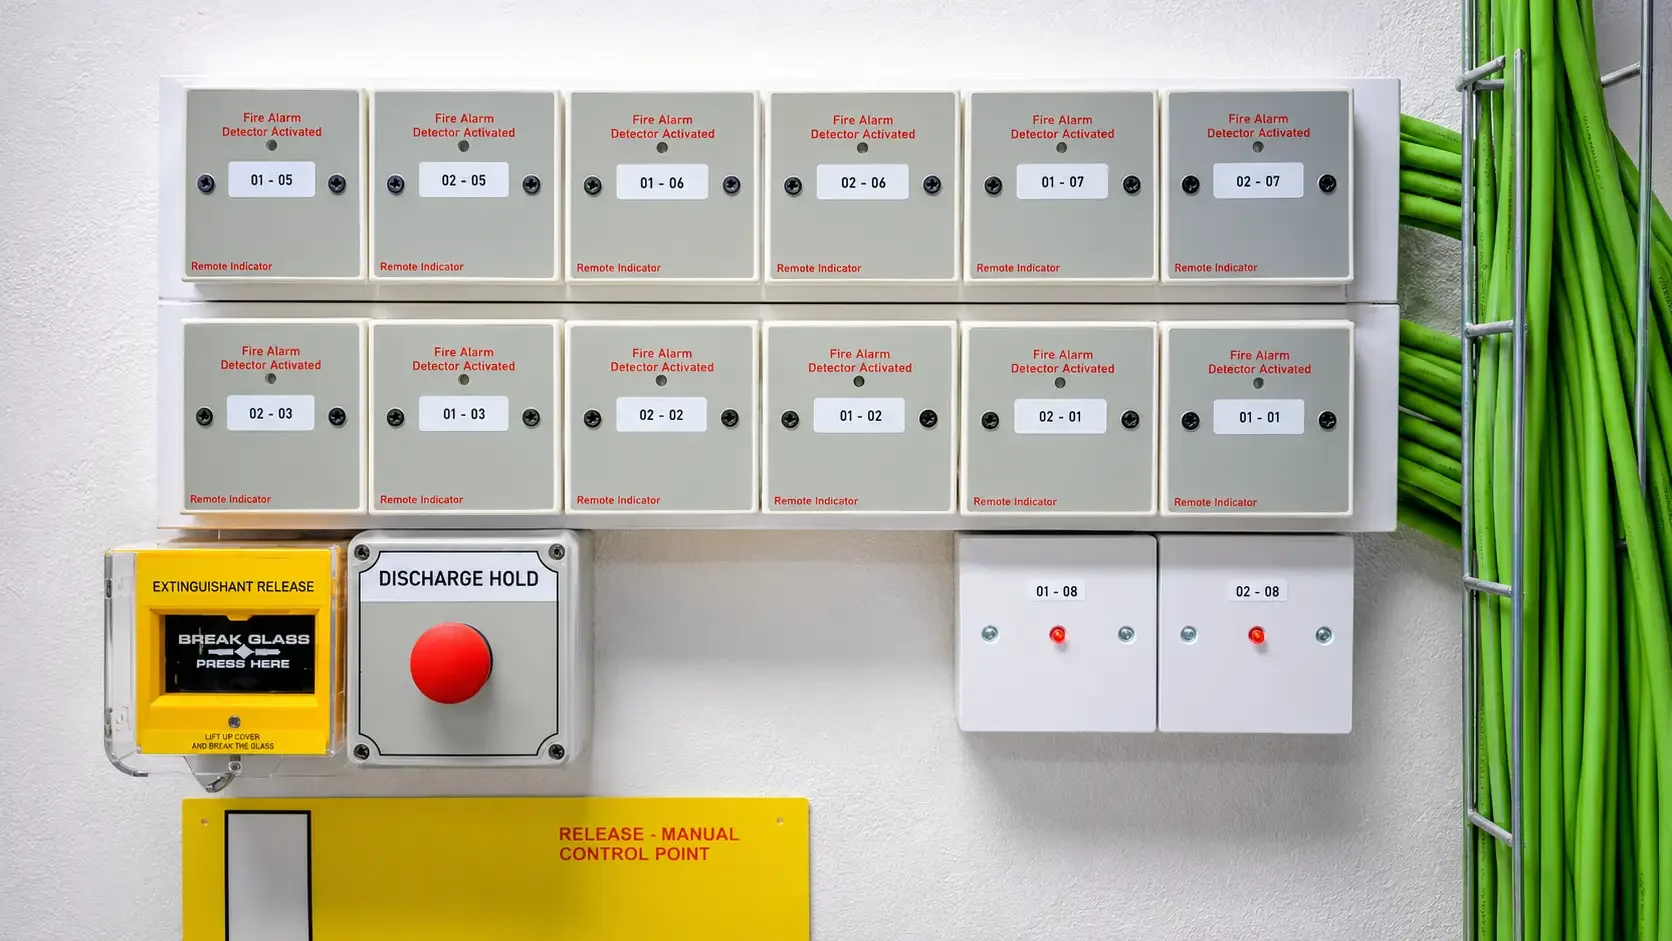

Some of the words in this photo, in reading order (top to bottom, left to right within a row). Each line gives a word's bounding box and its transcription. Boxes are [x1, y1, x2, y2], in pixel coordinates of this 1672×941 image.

[243, 112, 265, 123] Fire
[268, 112, 301, 123] Alarm
[435, 112, 458, 123] Fire
[460, 113, 495, 124] Alarm
[632, 114, 655, 124] Fire
[658, 114, 692, 125] Alarm
[833, 114, 856, 126] Fire
[859, 115, 894, 126] Alarm
[1033, 114, 1055, 124] Fire
[1058, 115, 1092, 126] Alarm
[1228, 114, 1250, 123] Fire
[1253, 114, 1288, 124] Alarm
[222, 127, 268, 137] Detector
[271, 126, 322, 137] Activated
[413, 128, 460, 137] Detector
[464, 128, 516, 138] Activated
[611, 128, 659, 139] Detector
[662, 128, 716, 139] Activated
[811, 129, 859, 139] Detector
[862, 129, 916, 140] Activated
[1011, 129, 1059, 139] Detector
[1062, 128, 1115, 139] Activated
[1208, 128, 1254, 138] Detector
[1258, 128, 1310, 137] Activated
[250, 173, 263, 186] 01
[278, 173, 293, 186] 05
[441, 174, 457, 187] 02
[471, 174, 486, 187] 05
[640, 176, 653, 189] 01
[669, 176, 684, 189] 06
[841, 176, 856, 189] 02
[871, 176, 887, 189] 06
[1041, 175, 1054, 189] 01
[1069, 175, 1085, 188] 07
[1236, 175, 1251, 188] 02
[1265, 175, 1280, 187] 07
[191, 261, 228, 271] Remote
[230, 261, 273, 271] Indicator
[380, 262, 418, 272] Remote
[420, 262, 464, 272] Indicator
[576, 264, 615, 273] Remote
[617, 264, 661, 273] Indicator
[776, 264, 815, 273] Remote
[818, 264, 861, 273] Indicator
[976, 264, 1015, 272] Remote
[1017, 264, 1060, 273] Indicator
[1175, 263, 1212, 272] Remote
[1215, 264, 1256, 272] Indicator
[242, 346, 264, 356] Fire
[266, 346, 300, 357] Alarm
[434, 346, 456, 358] Fire
[459, 347, 495, 357] Alarm
[632, 348, 655, 359] Fire
[657, 348, 692, 359] Alarm
[829, 348, 853, 359] Fire
[856, 348, 891, 359] Alarm
[1033, 349, 1055, 360] Fire
[1059, 350, 1093, 360] Alarm
[1230, 350, 1252, 360] Fire
[1256, 350, 1290, 360] Alarm
[221, 360, 266, 370] Detector
[270, 360, 321, 370] Activated
[412, 360, 459, 371] Detector
[463, 361, 516, 371] Activated
[610, 361, 658, 372] Detector
[661, 362, 715, 372] Activated
[808, 362, 856, 373] Detector
[859, 363, 912, 373] Activated
[1011, 363, 1059, 374] Detector
[1062, 364, 1115, 374] Activated
[1208, 364, 1255, 374] Detector
[1259, 364, 1312, 374] Activated
[249, 407, 264, 420] 02
[278, 407, 293, 420] 03
[443, 407, 456, 420] 01
[470, 407, 486, 420] 03
[639, 408, 654, 421] 02
[669, 408, 684, 421] 02
[839, 409, 852, 422] 01
[867, 409, 882, 422] 02
[1039, 410, 1054, 423] 02
[1068, 410, 1081, 423] 01
[1239, 411, 1252, 424] 01
[1267, 411, 1280, 424] 01
[189, 494, 227, 504] Remote
[229, 495, 271, 504] Indicator
[380, 495, 417, 504] Remote
[420, 496, 463, 504] Indicator
[577, 495, 614, 504] Remote
[617, 496, 660, 505] Indicator
[774, 496, 813, 505] Remote
[815, 497, 858, 505] Indicator
[973, 496, 1011, 506] Remote
[1013, 497, 1056, 506] Indicator
[1174, 497, 1211, 506] Remote
[1213, 498, 1256, 507] Indicator
[379, 570, 483, 587] DISCHARGE
[489, 570, 539, 587] HOLD
[153, 581, 254, 593] EXTINGUISHANT
[257, 581, 315, 593] RELEASE
[1036, 585, 1049, 597] 01
[1062, 585, 1078, 598] 08
[1236, 585, 1251, 598] 02
[1264, 585, 1280, 598] 08
[178, 634, 243, 645] BREAK
[248, 634, 310, 645] GLASS
[196, 659, 246, 669] PRESS
[250, 659, 290, 669] HERE
[205, 733, 221, 741] LIFT
[222, 733, 234, 741] UP
[234, 733, 260, 741] COVER
[192, 742, 207, 750] AND
[209, 742, 233, 750] BREAK
[236, 742, 249, 750] THE
[251, 742, 275, 750] GLASS
[559, 827, 644, 841] RELEASE
[662, 827, 740, 841] MANUAL
[560, 847, 649, 861] CONTROL
[655, 847, 710, 861] POINT
